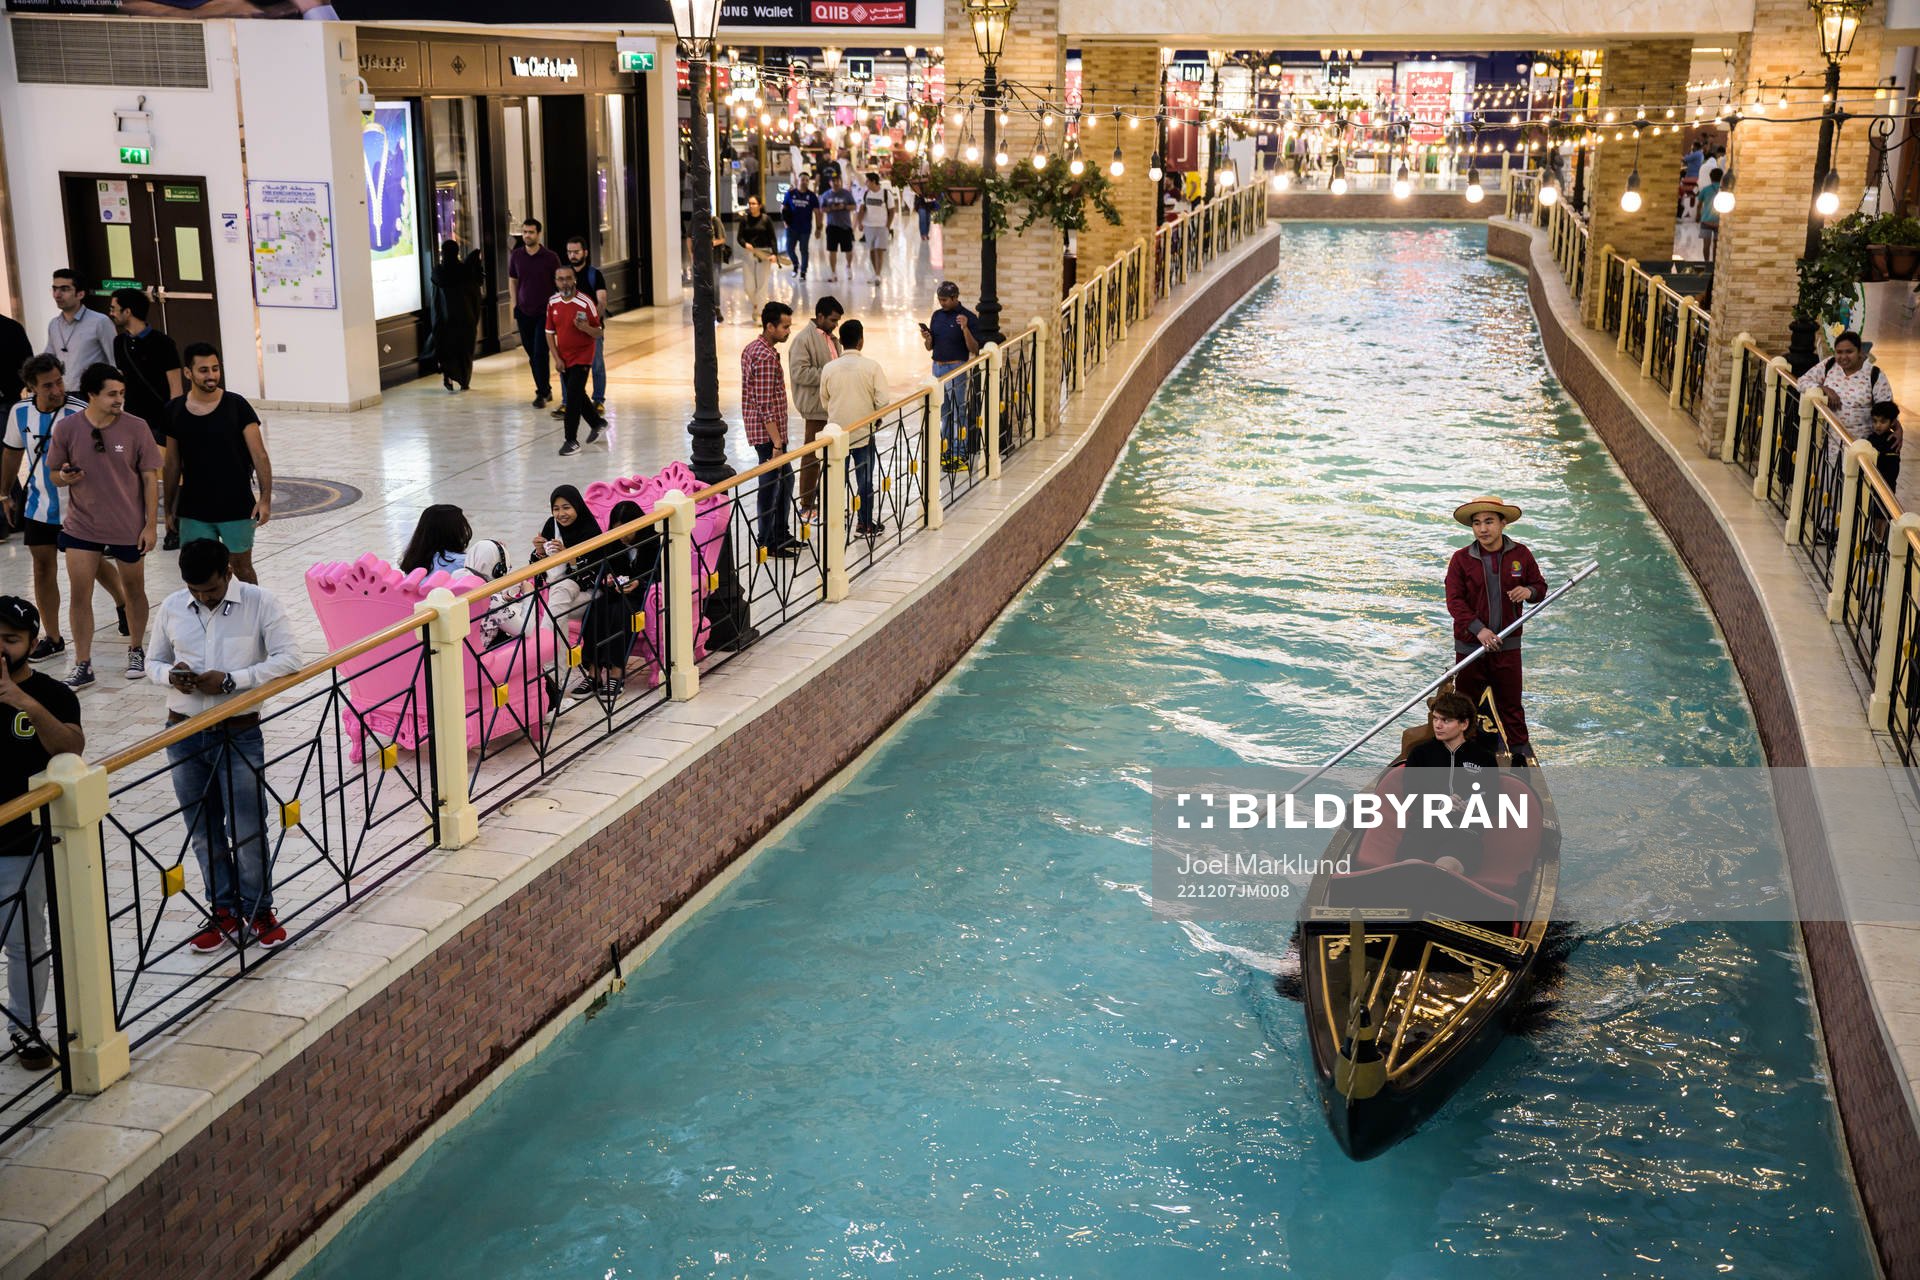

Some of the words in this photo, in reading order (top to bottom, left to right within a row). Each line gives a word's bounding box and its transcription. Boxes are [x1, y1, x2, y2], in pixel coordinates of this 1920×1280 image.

[719, 5, 748, 17] UNG
[753, 6, 793, 18] Wallet
[815, 5, 849, 20] QIIB
[512, 56, 529, 77] Van
[1414, 111, 1443, 124] SALE
[14, 711, 36, 738] C
